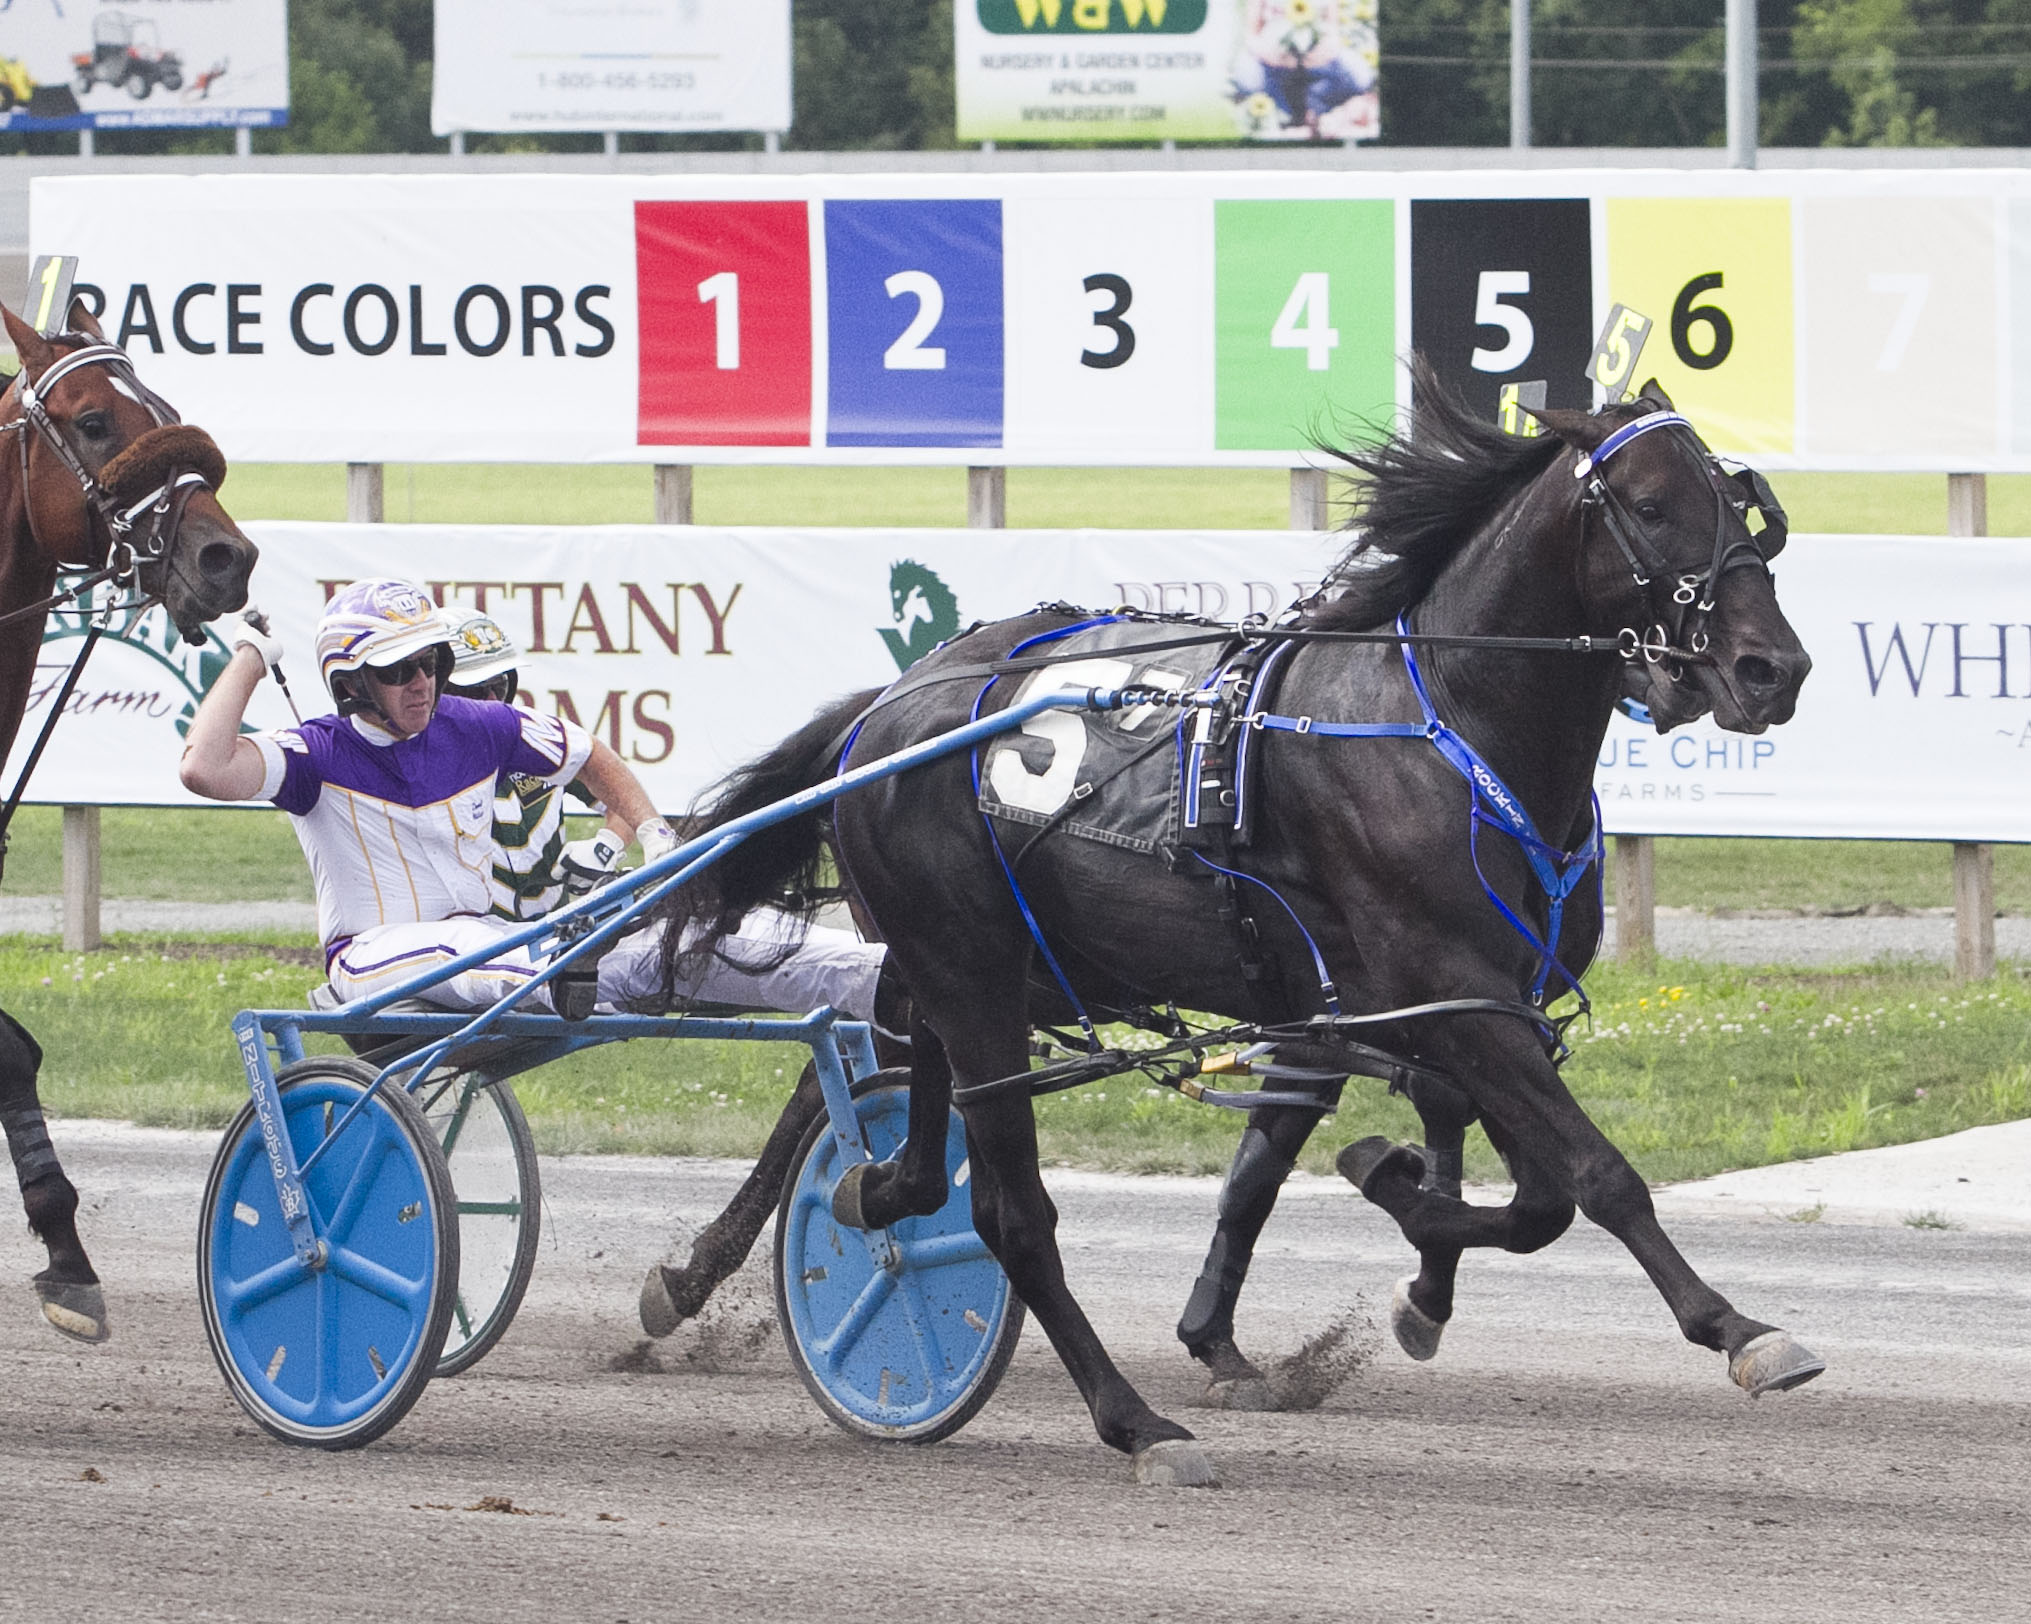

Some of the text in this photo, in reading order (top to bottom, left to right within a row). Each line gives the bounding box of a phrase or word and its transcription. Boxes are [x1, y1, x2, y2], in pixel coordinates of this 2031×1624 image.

[35, 256, 62, 332] 1
[290, 284, 615, 357] COLORS
[698, 272, 740, 370] 1
[884, 271, 946, 370] 2
[1080, 273, 1136, 370] 3
[1270, 272, 1339, 370] 4
[1471, 270, 1534, 373] 5
[1670, 271, 1734, 371] 6
[1868, 272, 1932, 372] 7
[1595, 310, 1646, 387] 5
[990, 658, 1134, 816] 5
[1670, 735, 1776, 770] CHIP
[1601, 782, 1705, 802] FARMS
